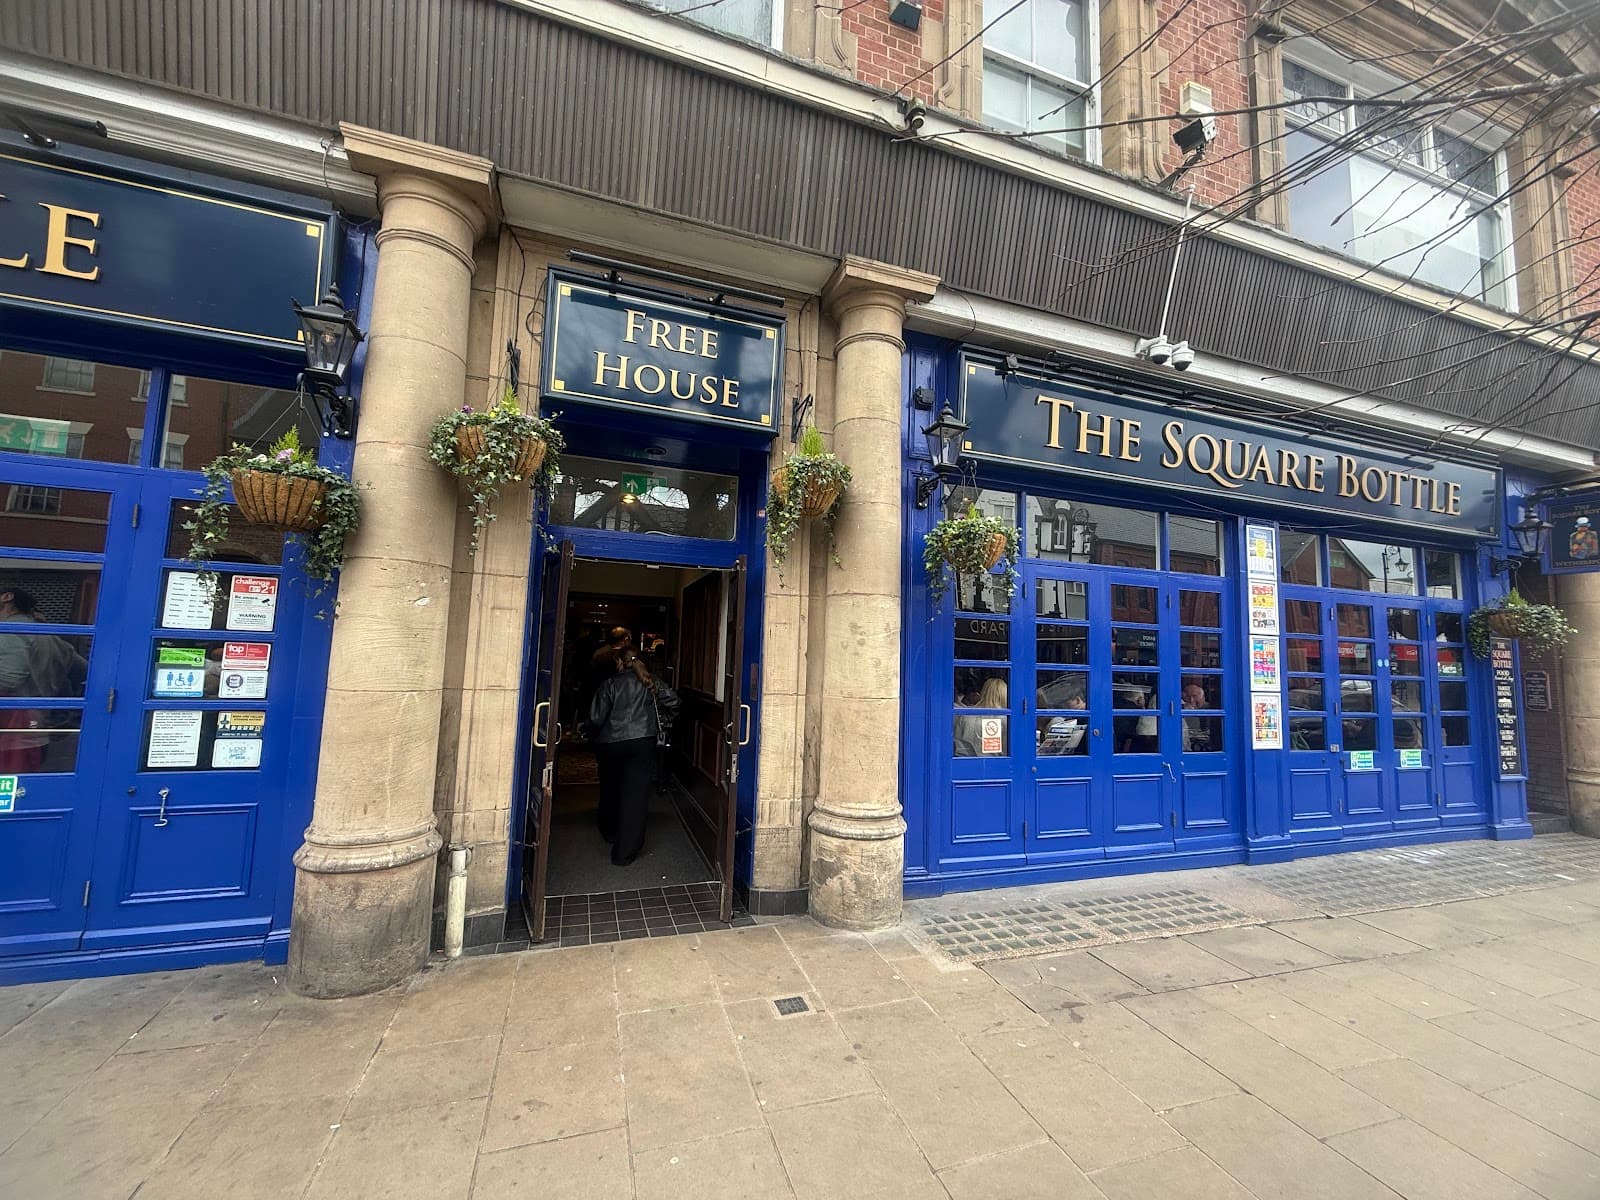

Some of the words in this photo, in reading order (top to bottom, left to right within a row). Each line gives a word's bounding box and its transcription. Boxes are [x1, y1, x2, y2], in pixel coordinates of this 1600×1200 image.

[624, 308, 720, 359] FREE
[592, 350, 740, 408] HOUSE
[1035, 394, 1142, 462] THE
[1162, 420, 1325, 493] SQUARE
[1336, 454, 1462, 516] BOTTLE
[235, 577, 271, 587] challenge
[261, 585, 275, 594] 21
[1491, 650, 1512, 659] SQUARE
[1493, 659, 1513, 669] BOTTLE
